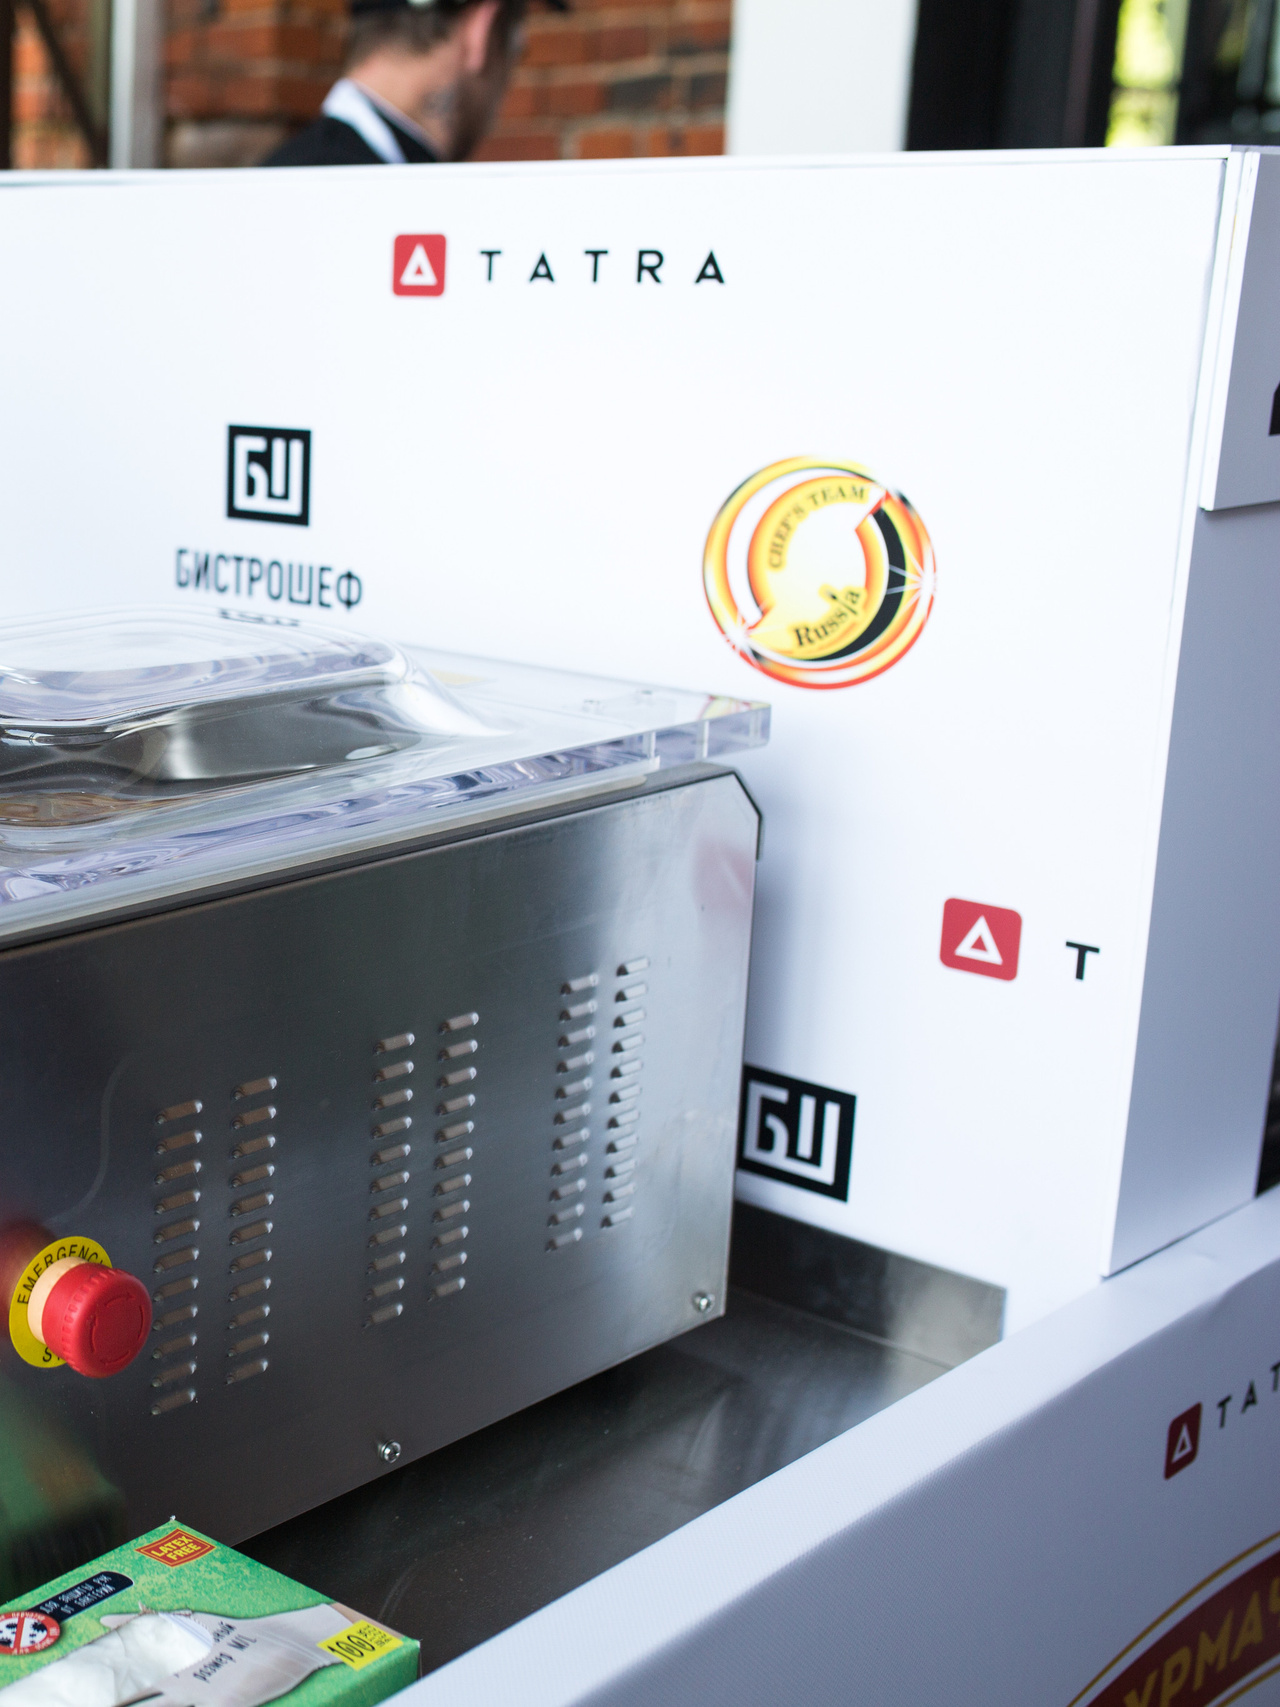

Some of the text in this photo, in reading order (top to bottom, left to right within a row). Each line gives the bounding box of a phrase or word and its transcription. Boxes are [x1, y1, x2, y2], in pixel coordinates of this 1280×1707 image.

[479, 248, 726, 285] TATRA
[768, 484, 867, 570] CHEF'S TEAM
[175, 547, 364, 612] БИСТРОШЕФ
[1065, 940, 1101, 981] T
[17, 1244, 104, 1305] EMERGENC
[150, 1535, 193, 1558] LATEX
[166, 1544, 202, 1562] FREE
[193, 1633, 257, 1684] размер M/L
[327, 1634, 376, 1664] 100
